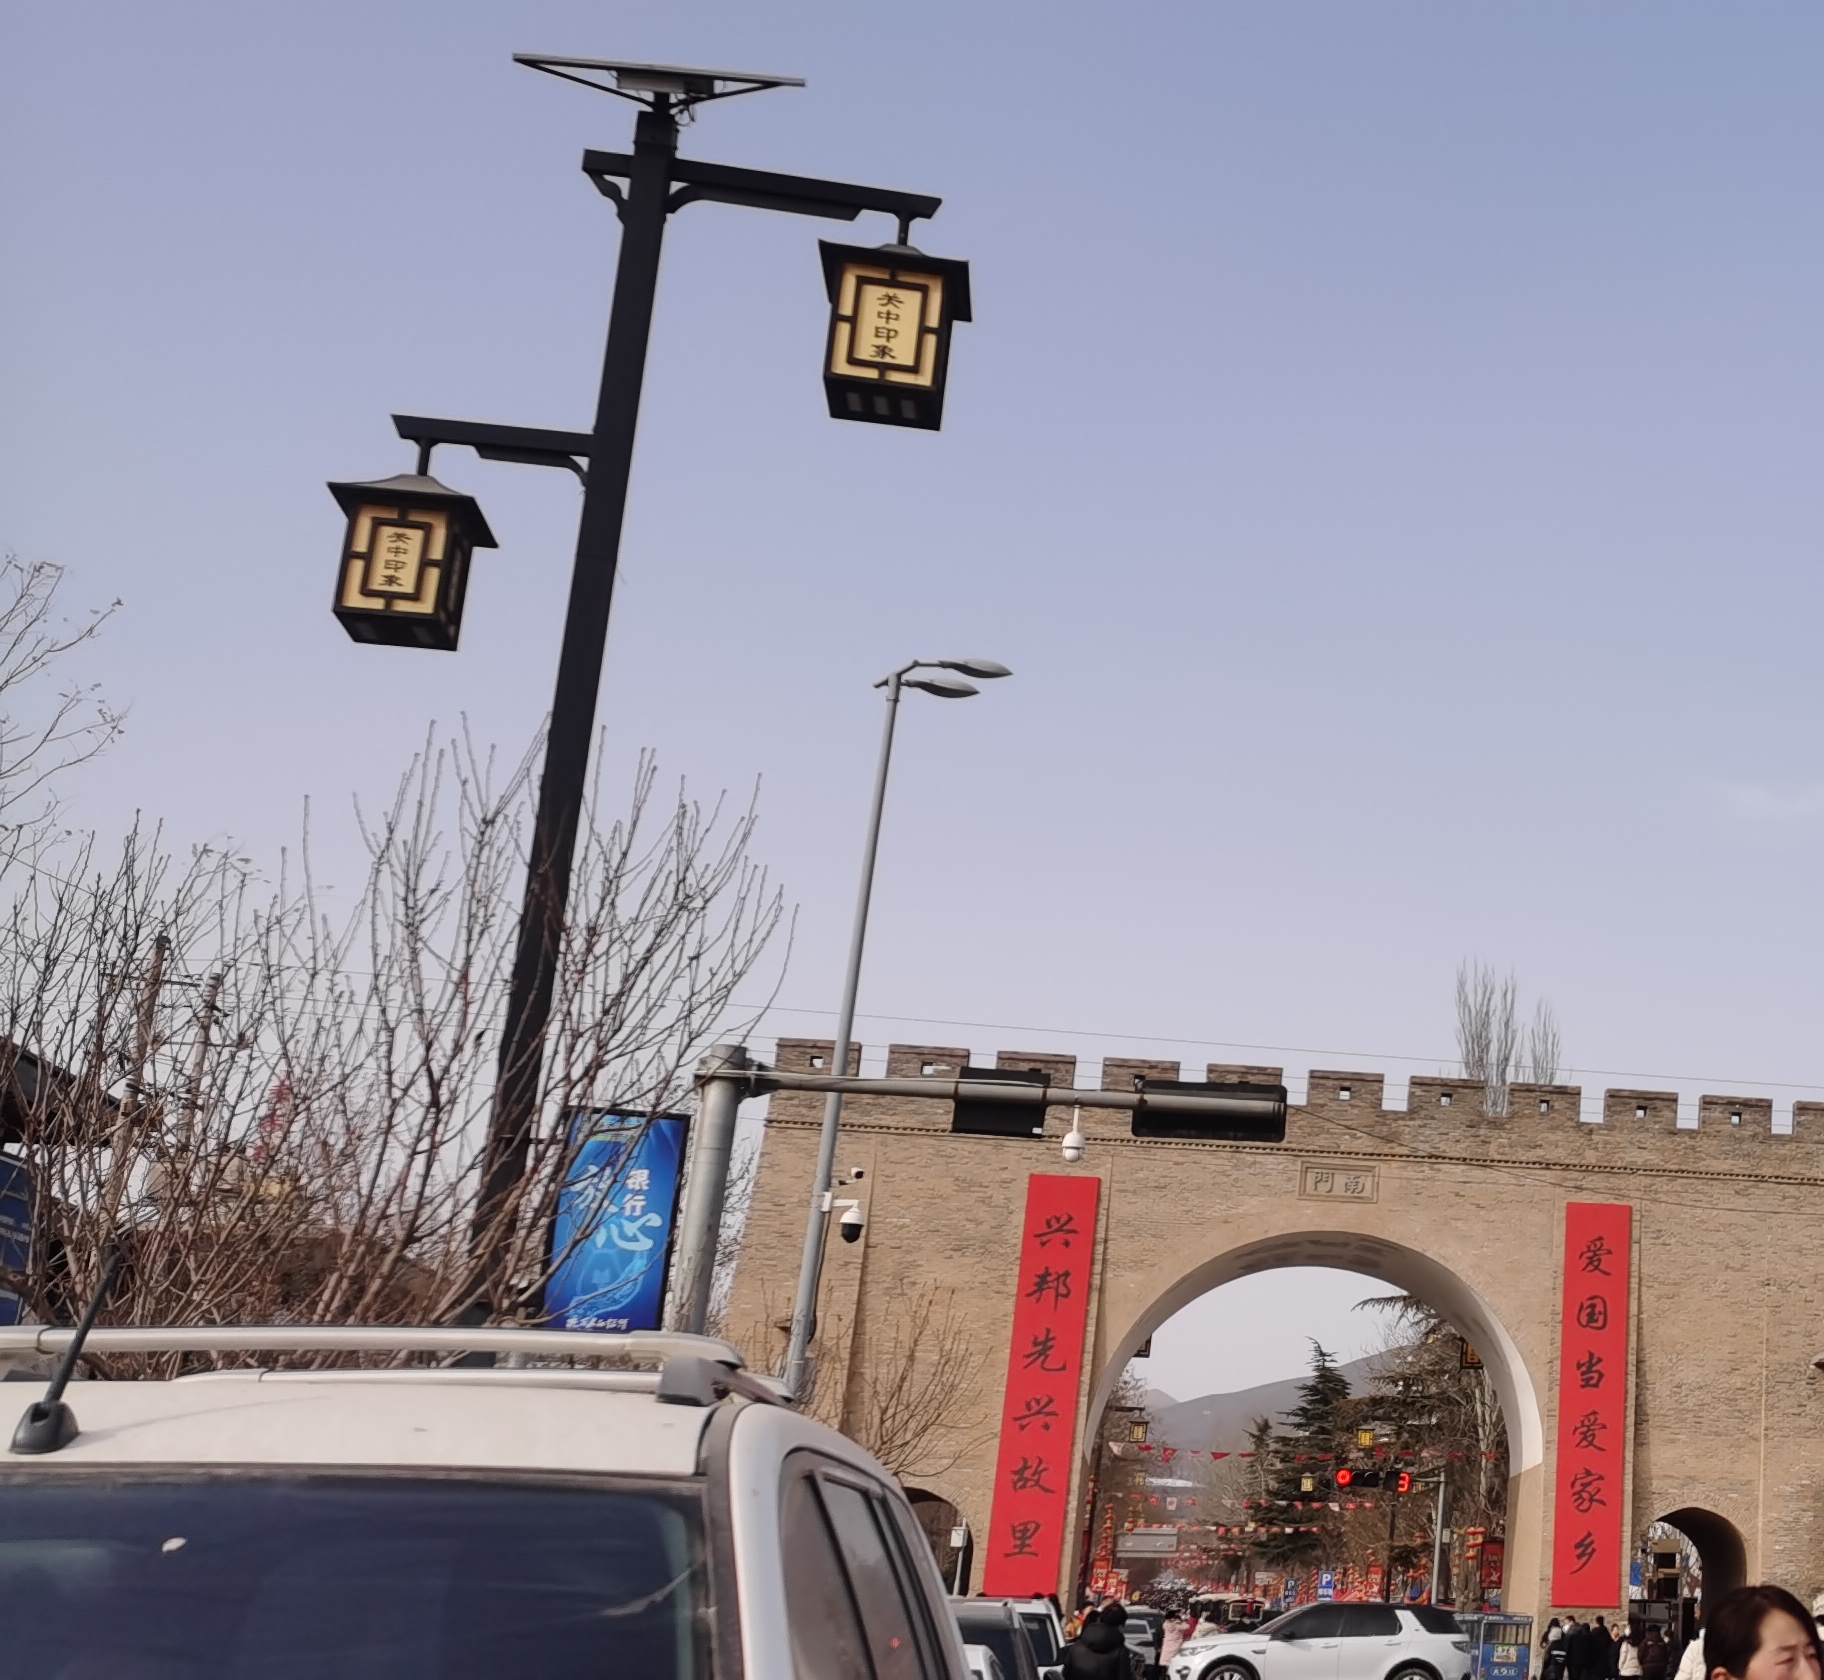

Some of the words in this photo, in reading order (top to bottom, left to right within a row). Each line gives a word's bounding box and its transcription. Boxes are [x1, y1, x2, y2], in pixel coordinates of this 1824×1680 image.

[869, 291, 905, 360] 关中印象
[378, 532, 413, 587] 关中印象
[1003, 1211, 1079, 1560] 兴邦先兴故里
[1569, 1234, 1613, 1576] 爱国当爱家乡
